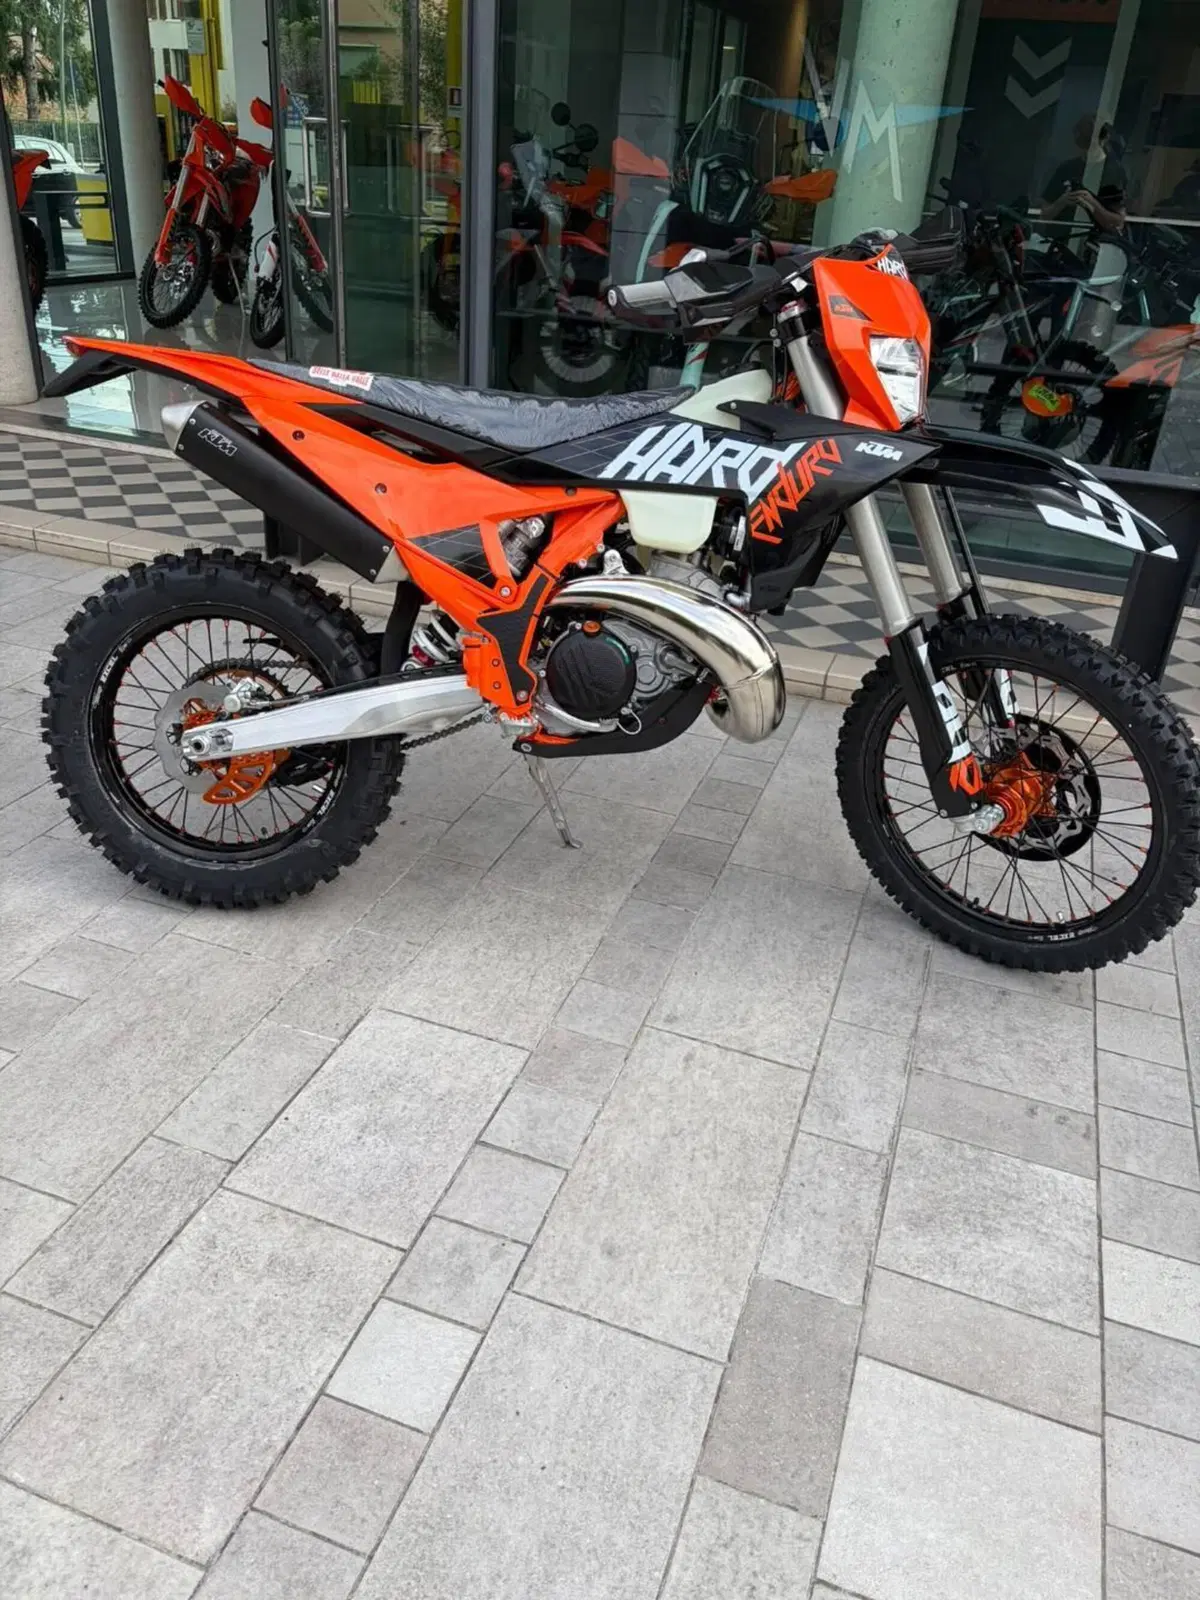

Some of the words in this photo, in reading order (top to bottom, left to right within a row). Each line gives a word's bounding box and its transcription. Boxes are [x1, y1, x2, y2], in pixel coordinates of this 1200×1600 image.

[198, 427, 239, 457] KTM
[854, 440, 903, 462] KTM
[597, 422, 807, 504] HARD
